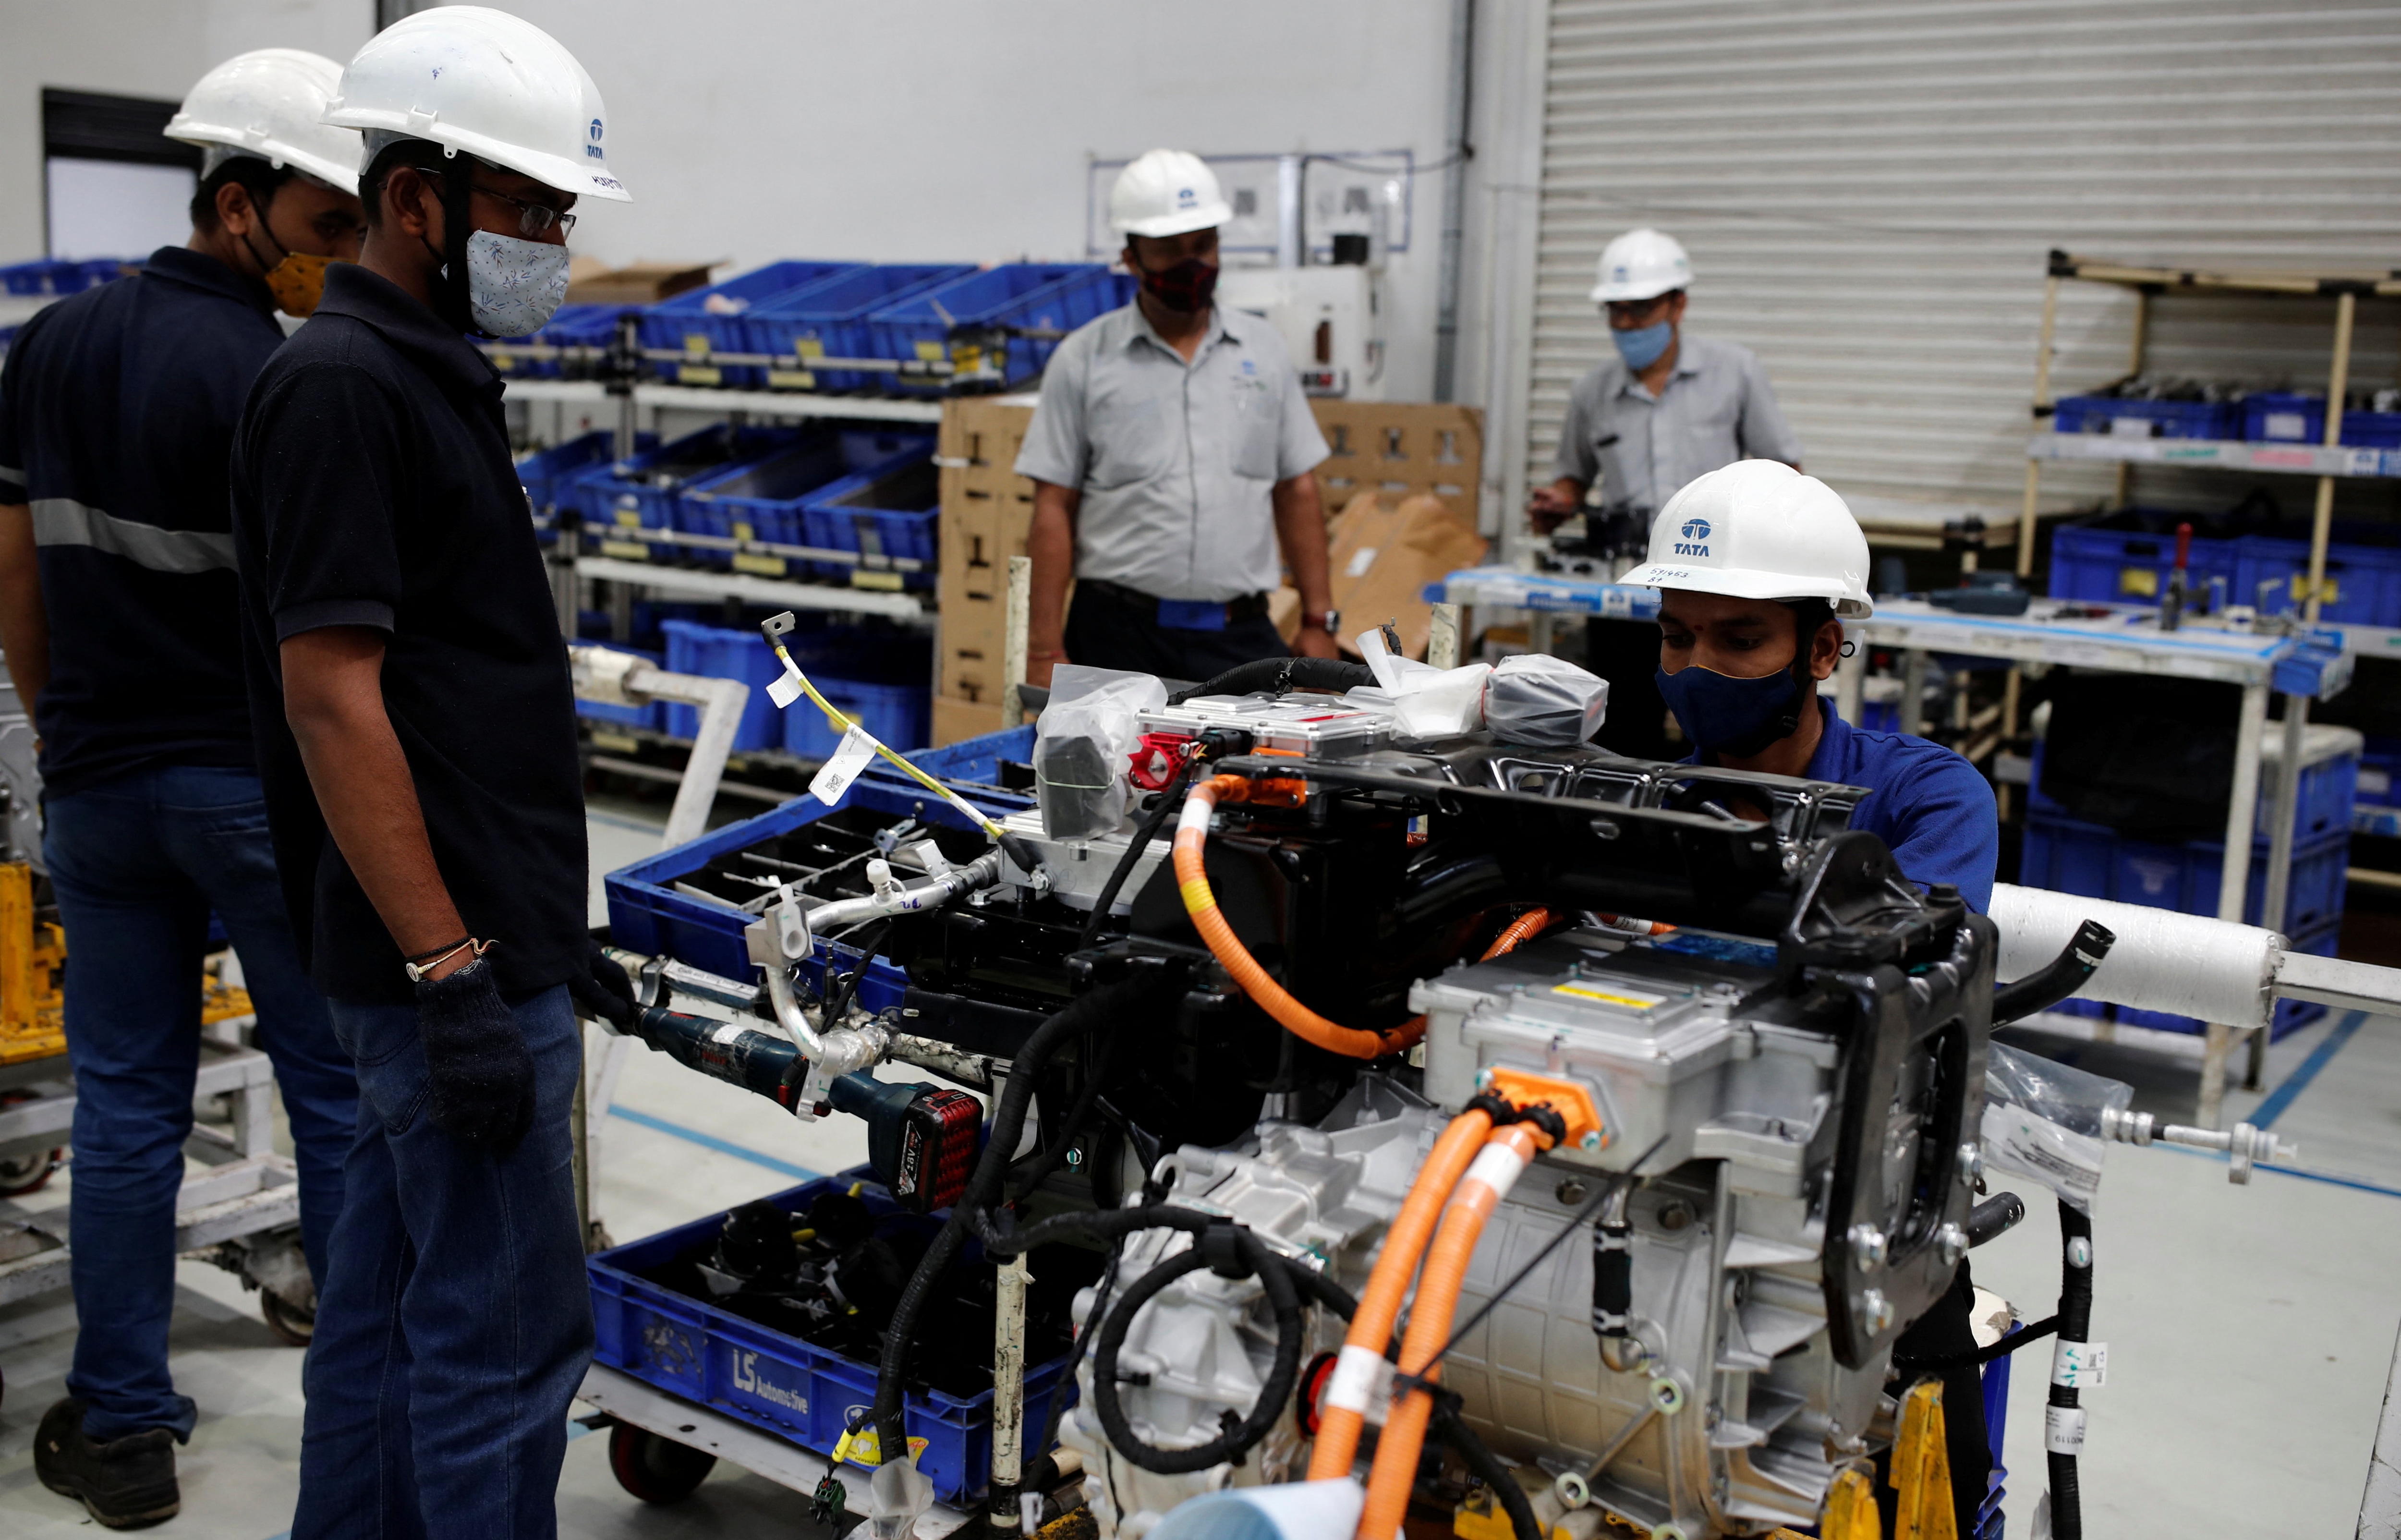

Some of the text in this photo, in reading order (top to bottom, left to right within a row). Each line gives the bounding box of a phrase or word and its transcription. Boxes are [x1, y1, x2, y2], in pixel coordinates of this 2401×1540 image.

[587, 145, 603, 159] TATA
[1674, 543, 1709, 557] TATA
[906, 1148, 916, 1172] 18V
[733, 1348, 758, 1393] LS
[756, 1375, 809, 1415] Automotive
